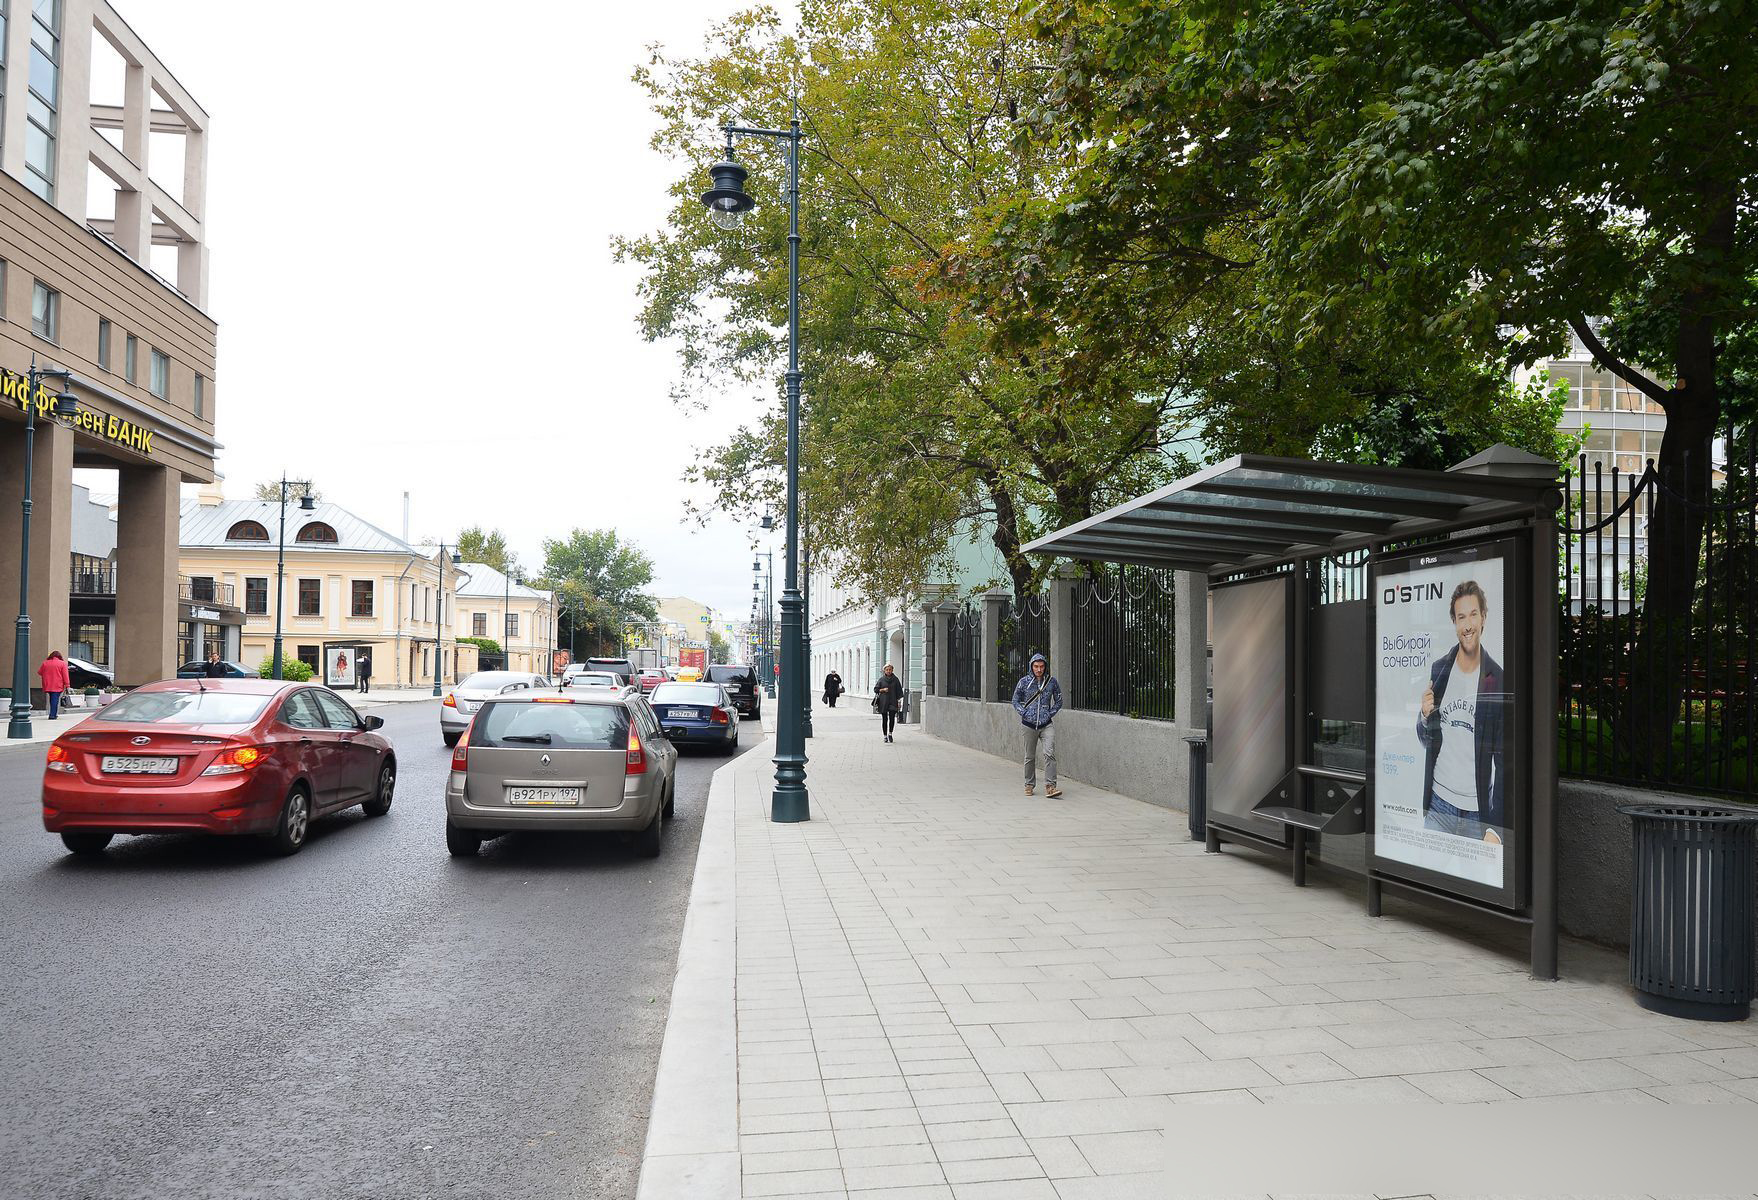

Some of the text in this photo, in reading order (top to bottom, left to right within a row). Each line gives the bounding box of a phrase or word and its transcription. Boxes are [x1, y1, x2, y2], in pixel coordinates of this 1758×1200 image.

[107, 415, 153, 454] БАНК
[1383, 582, 1443, 605] O'STIN
[1383, 633, 1431, 653] Выбирай
[1383, 651, 1426, 668] сочетай
[560, 788, 576, 797] 197
[1383, 803, 1418, 815] www.ostin.com
